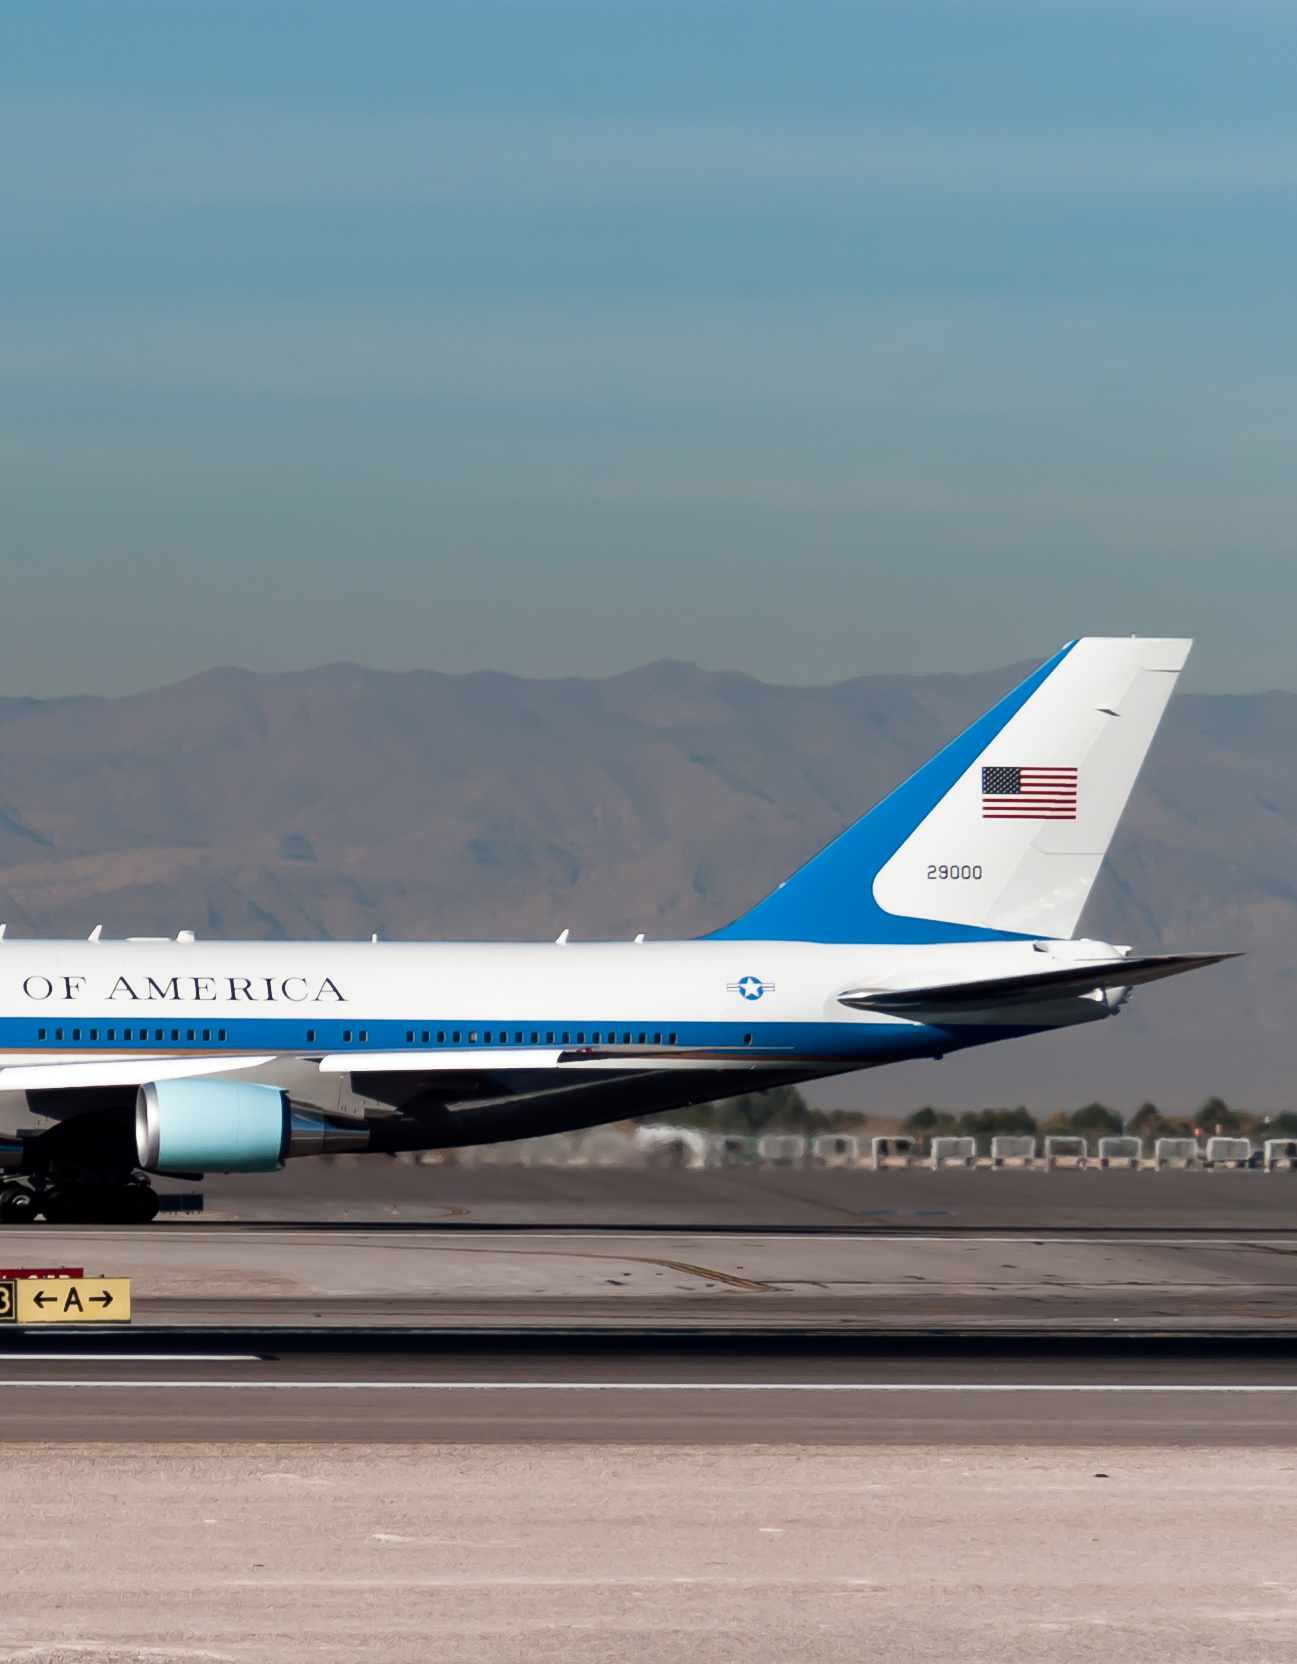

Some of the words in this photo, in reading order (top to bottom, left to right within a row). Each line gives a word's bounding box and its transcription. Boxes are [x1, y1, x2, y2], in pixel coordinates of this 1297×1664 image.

[927, 865, 982, 880] 29000
[22, 975, 87, 1001] OF
[106, 975, 349, 1002] AMERICA
[63, 1286, 83, 1312] A
